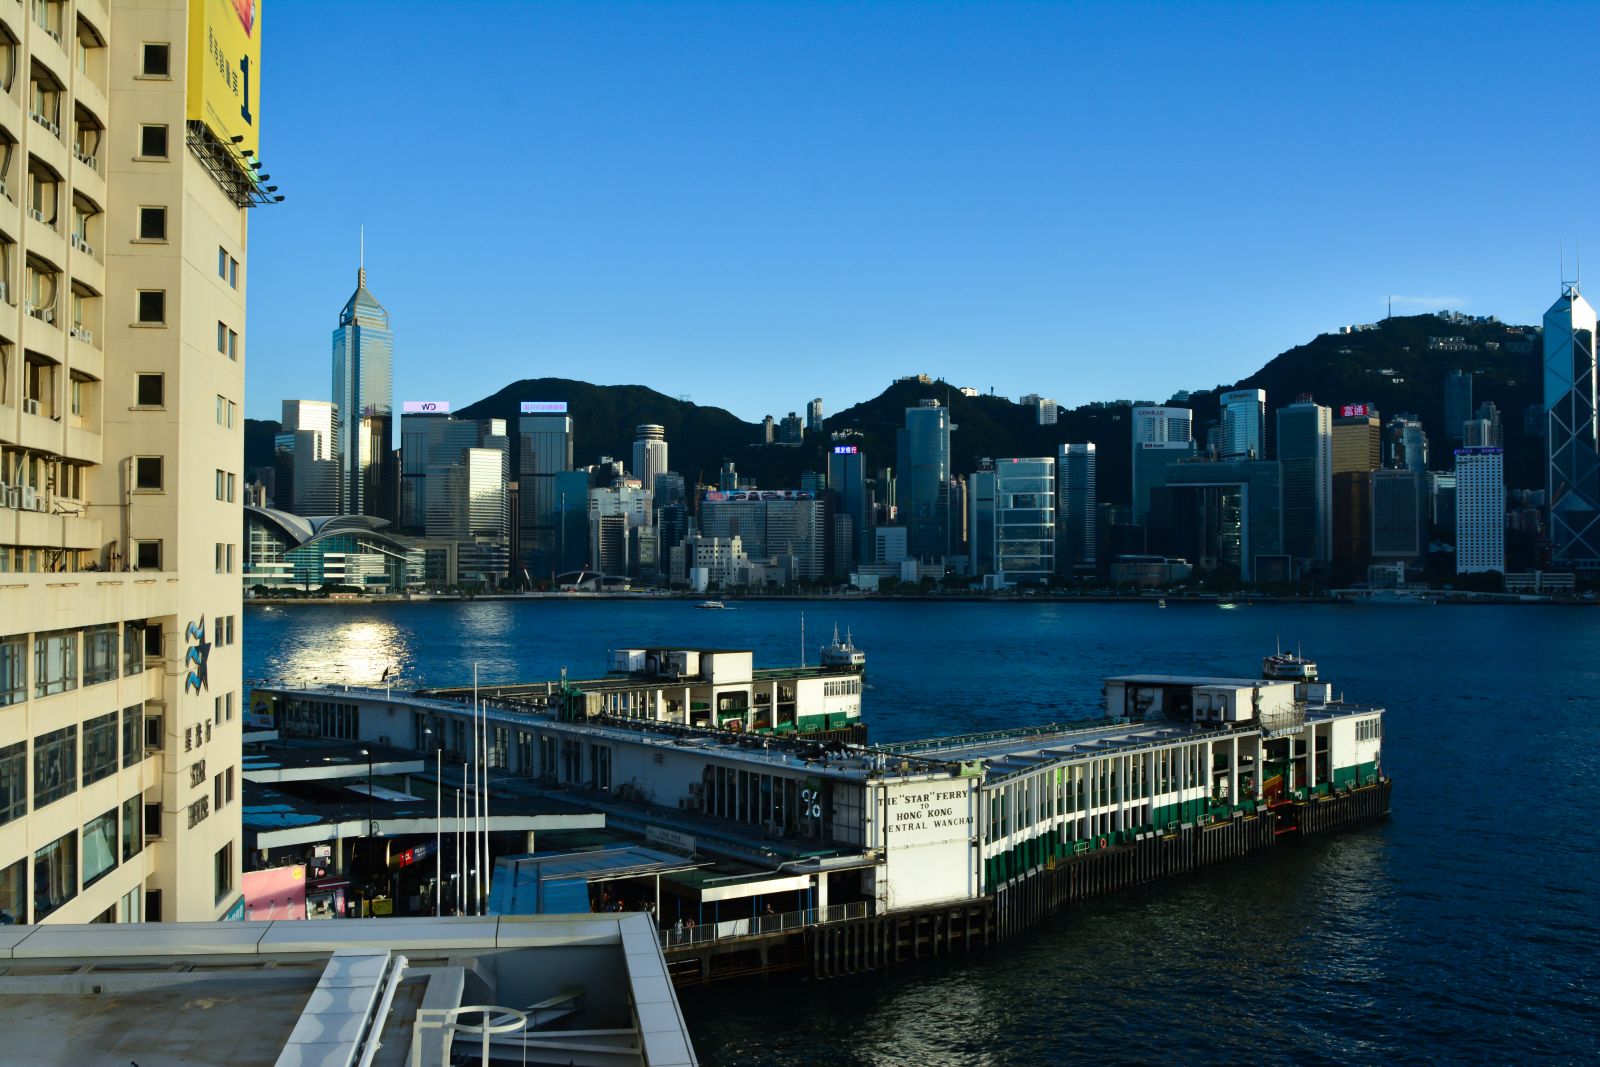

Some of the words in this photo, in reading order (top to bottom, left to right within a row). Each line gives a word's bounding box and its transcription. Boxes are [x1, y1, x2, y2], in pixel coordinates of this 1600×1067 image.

[421, 403, 437, 411] WD
[190, 759, 206, 789] STAR
[936, 790, 968, 801] FERRY
[896, 811, 922, 821] HONG
[927, 807, 953, 818] KONG
[934, 816, 974, 828] WANCHAI
